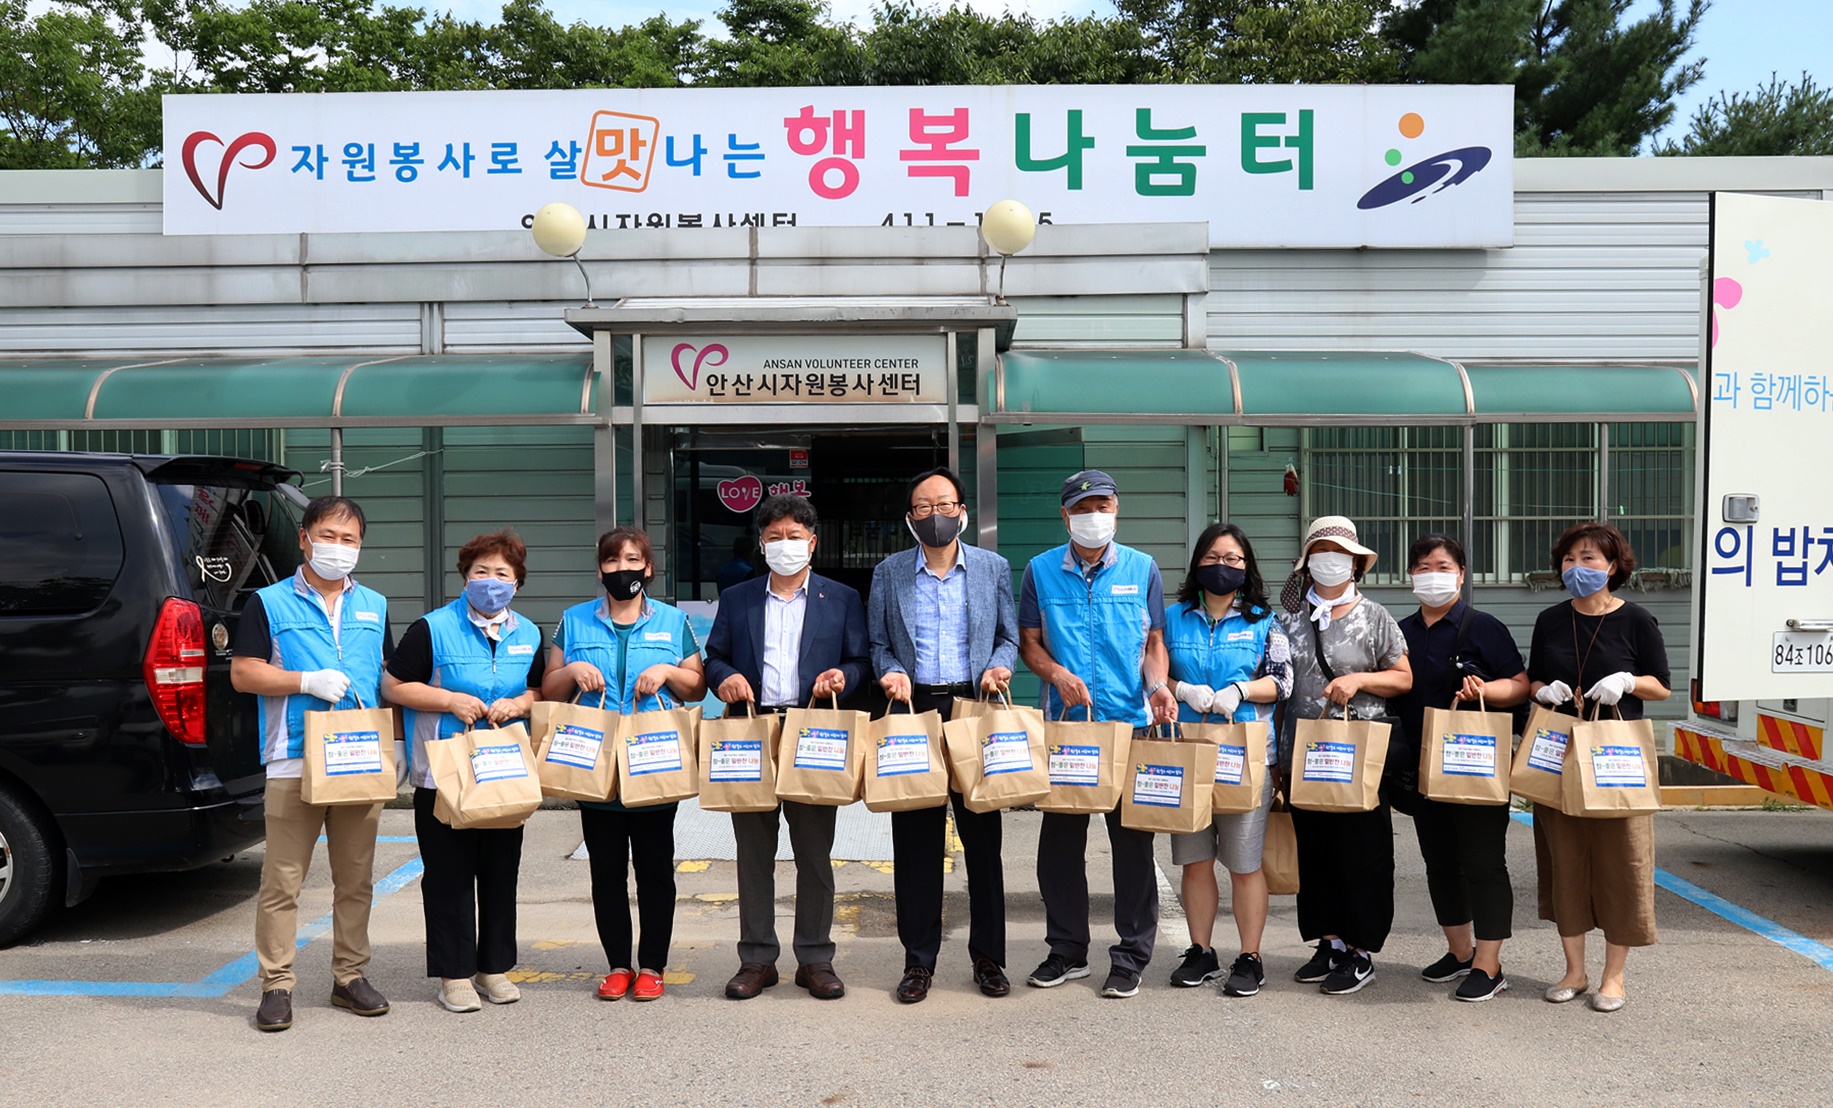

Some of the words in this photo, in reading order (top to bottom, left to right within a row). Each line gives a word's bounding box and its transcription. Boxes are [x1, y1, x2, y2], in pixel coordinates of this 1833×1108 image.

[290, 140, 523, 183] 자원봉사로
[544, 127, 766, 182] 살맛나는
[763, 359, 802, 369] ANSAN
[805, 359, 871, 369] VOLUNTEER
[874, 359, 919, 369] CENTER
[706, 373, 921, 397] 안산시자원봉사센터
[1713, 372, 1741, 409] 과
[721, 487, 760, 500] LOVE
[1712, 525, 1753, 587] 의
